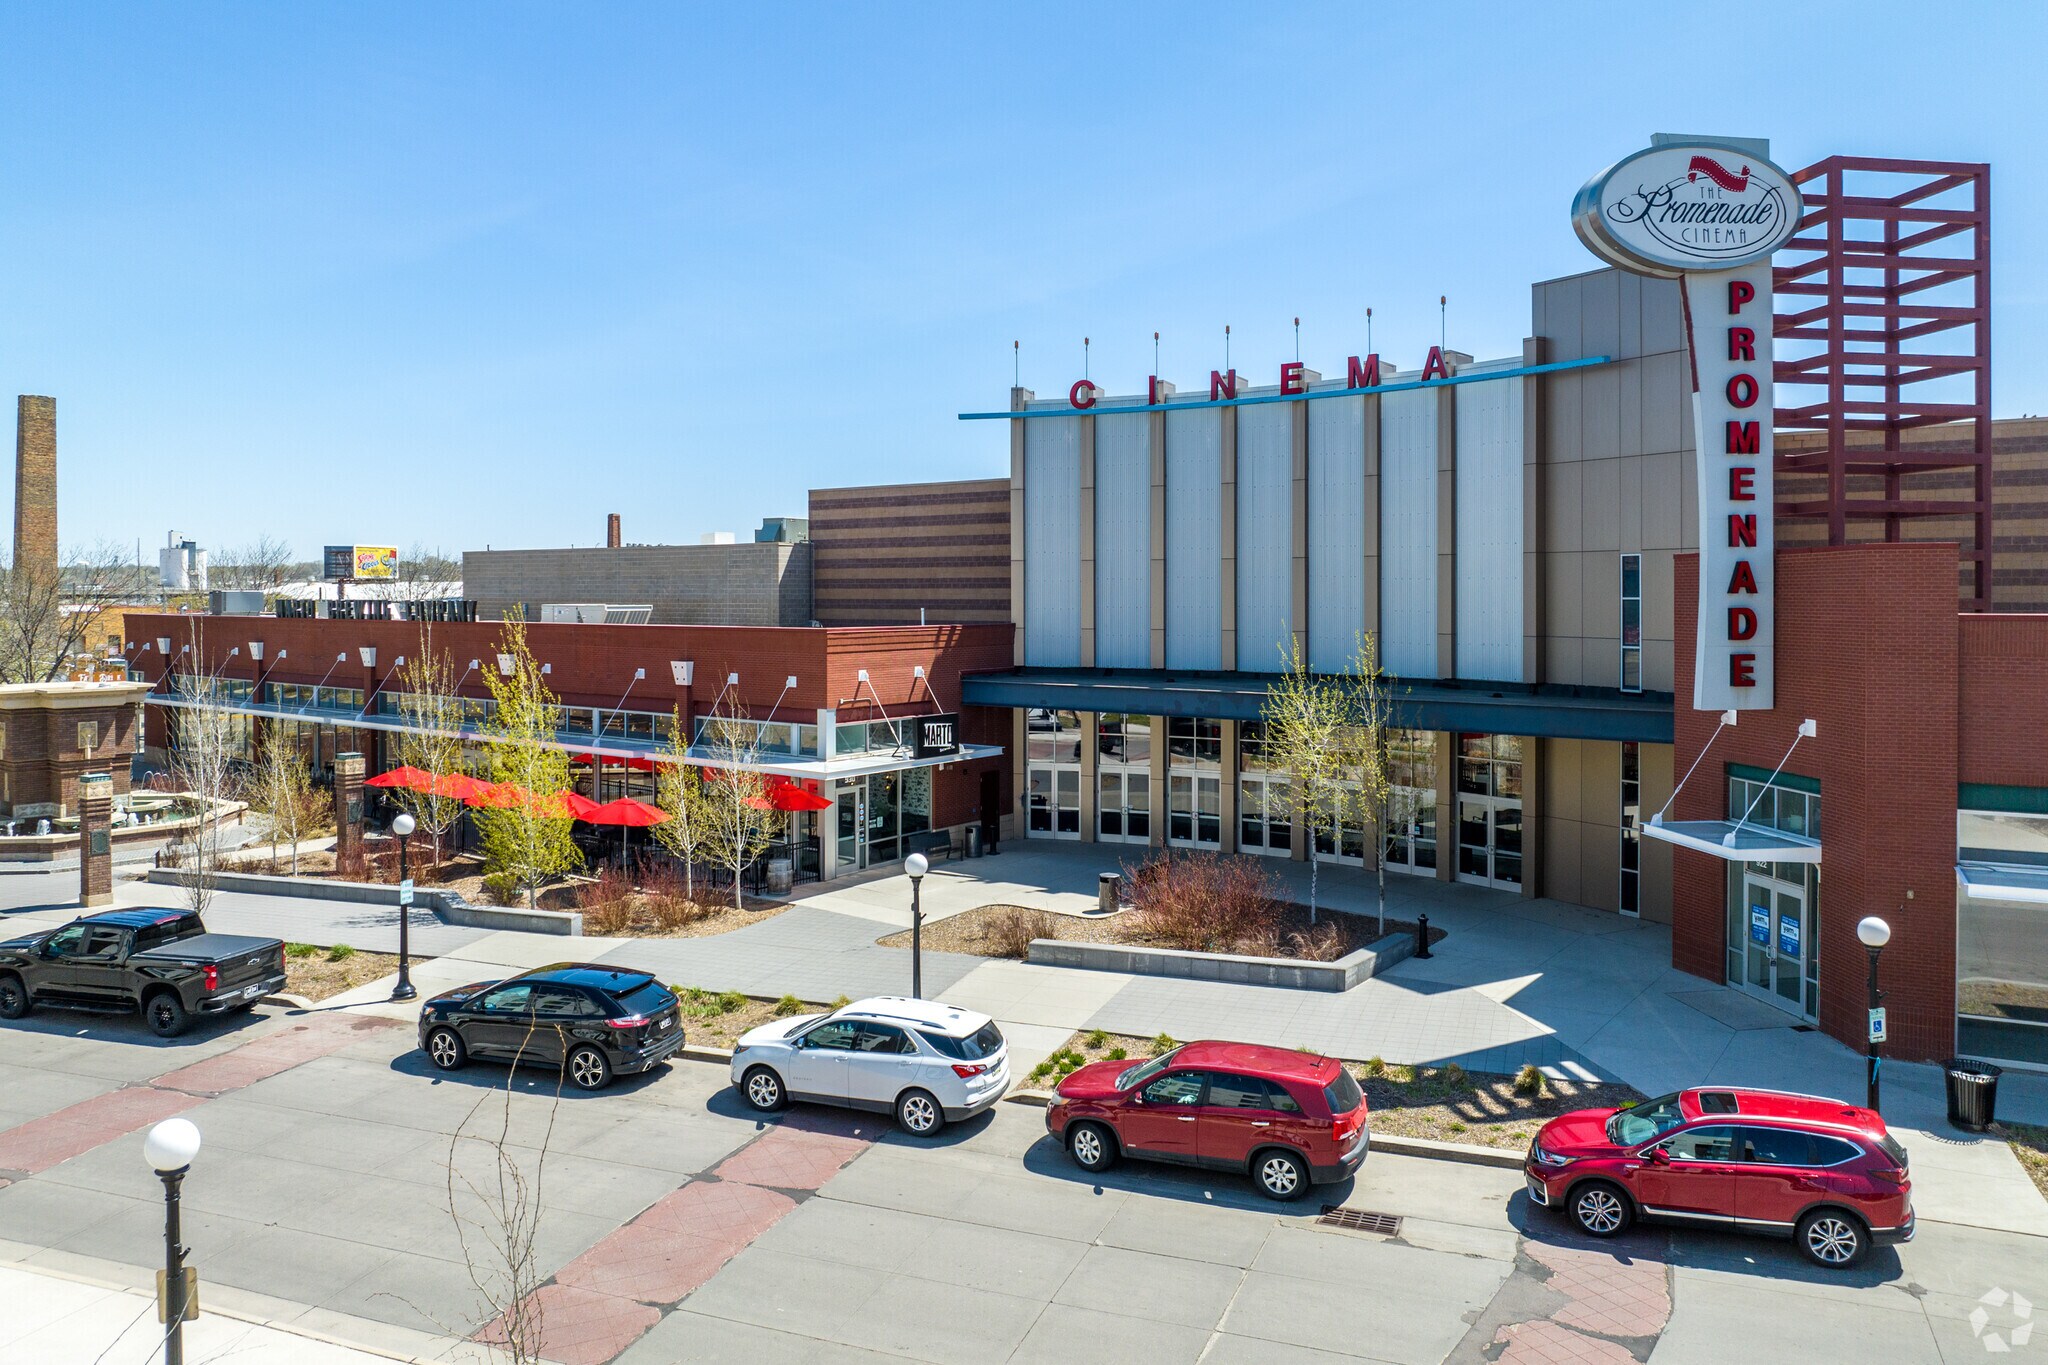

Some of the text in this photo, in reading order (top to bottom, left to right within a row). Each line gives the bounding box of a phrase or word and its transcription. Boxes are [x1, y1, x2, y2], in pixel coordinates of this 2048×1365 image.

[1607, 184, 1780, 225] Promenade
[1700, 186, 1722, 199] THE
[1681, 227, 1746, 244] CINEMA
[1070, 346, 1447, 409] CINEMA
[1726, 281, 1759, 687] PROMENADE
[1756, 861, 1768, 869] 922
